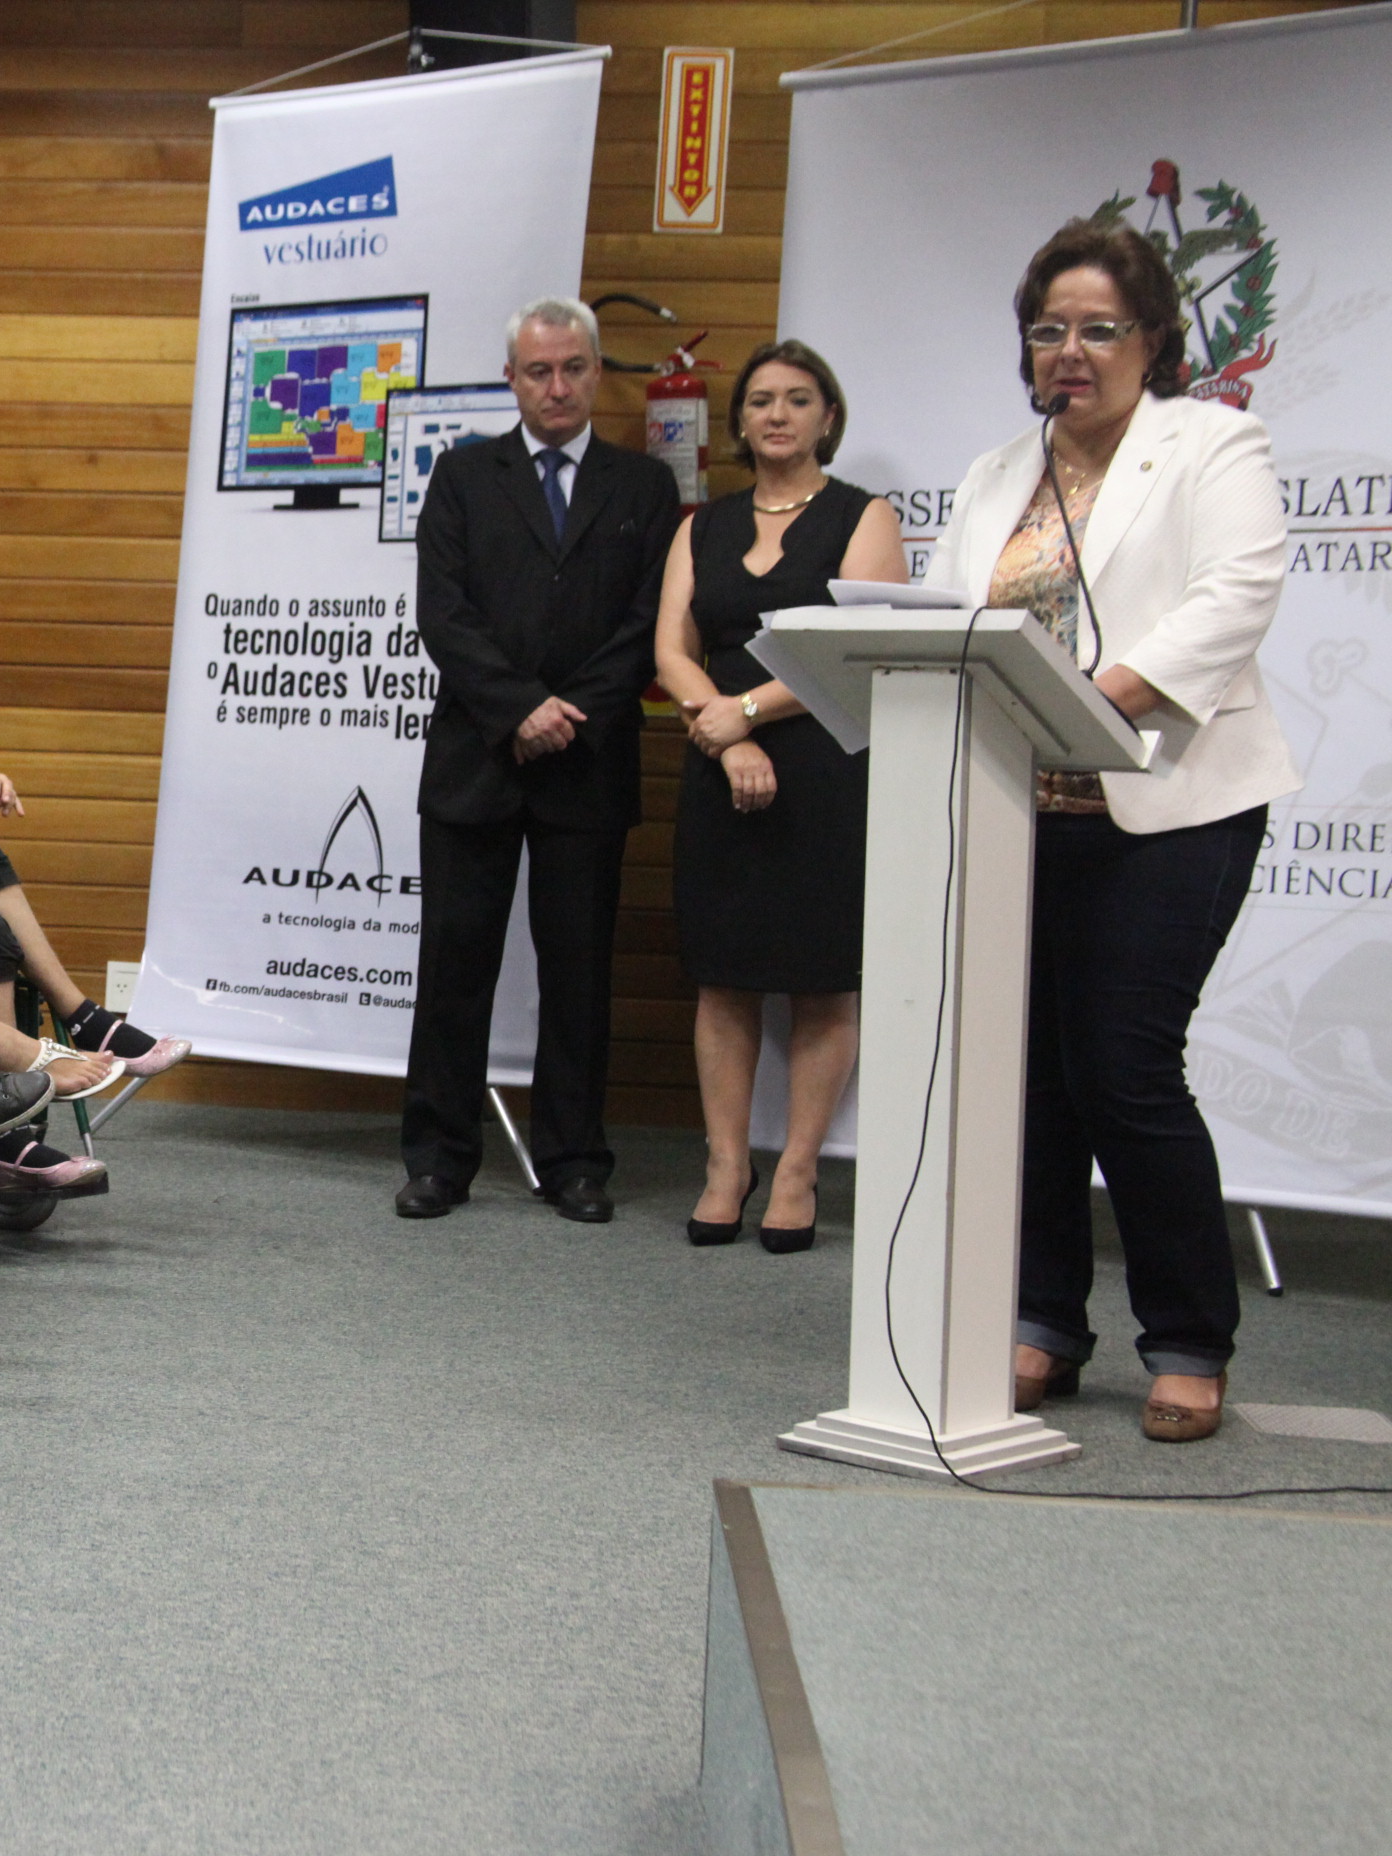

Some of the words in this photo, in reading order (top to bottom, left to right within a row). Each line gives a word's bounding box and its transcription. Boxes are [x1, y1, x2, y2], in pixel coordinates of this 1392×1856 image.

[246, 192, 390, 224] AUDACES
[264, 226, 388, 265] vestuário
[204, 593, 280, 618] Quando
[288, 598, 300, 618] o
[308, 594, 386, 618] assunto
[395, 593, 406, 618] é
[223, 621, 372, 664] tecnologia
[386, 622, 420, 658] da
[207, 661, 218, 680] o
[220, 662, 348, 699] Audaces
[216, 700, 227, 723] é
[236, 704, 311, 730] sempre
[320, 707, 331, 727] o
[340, 704, 390, 728] mais
[262, 912, 272, 925] a
[277, 911, 356, 932] tecnologia
[362, 918, 382, 932] da
[265, 957, 413, 987] audaces.com
[218, 981, 349, 1003] fb.com/audacesbrasil
